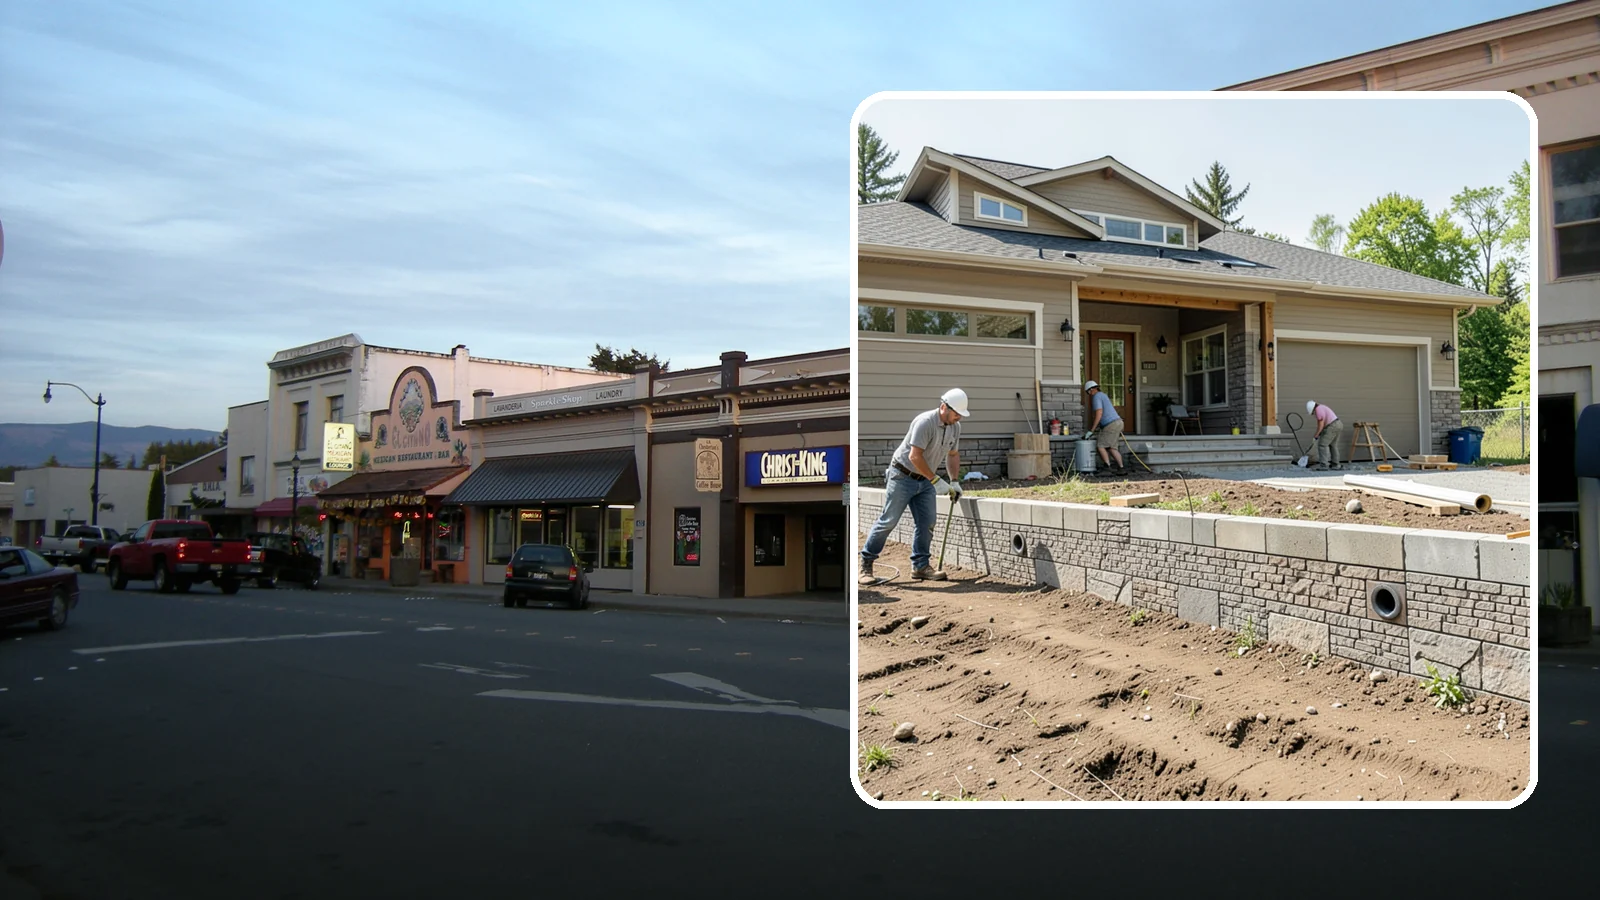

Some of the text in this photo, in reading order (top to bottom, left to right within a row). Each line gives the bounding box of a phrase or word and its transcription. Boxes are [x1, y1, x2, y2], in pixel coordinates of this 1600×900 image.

[561, 394, 582, 406] Shop
[595, 389, 623, 400] LAUNDRY
[493, 402, 523, 413] LAVANDERIA
[327, 449, 352, 457] MEXICAN
[397, 451, 433, 462] RESTAURANT
[438, 450, 450, 459] BAR
[760, 450, 828, 478] CHRIST KING
